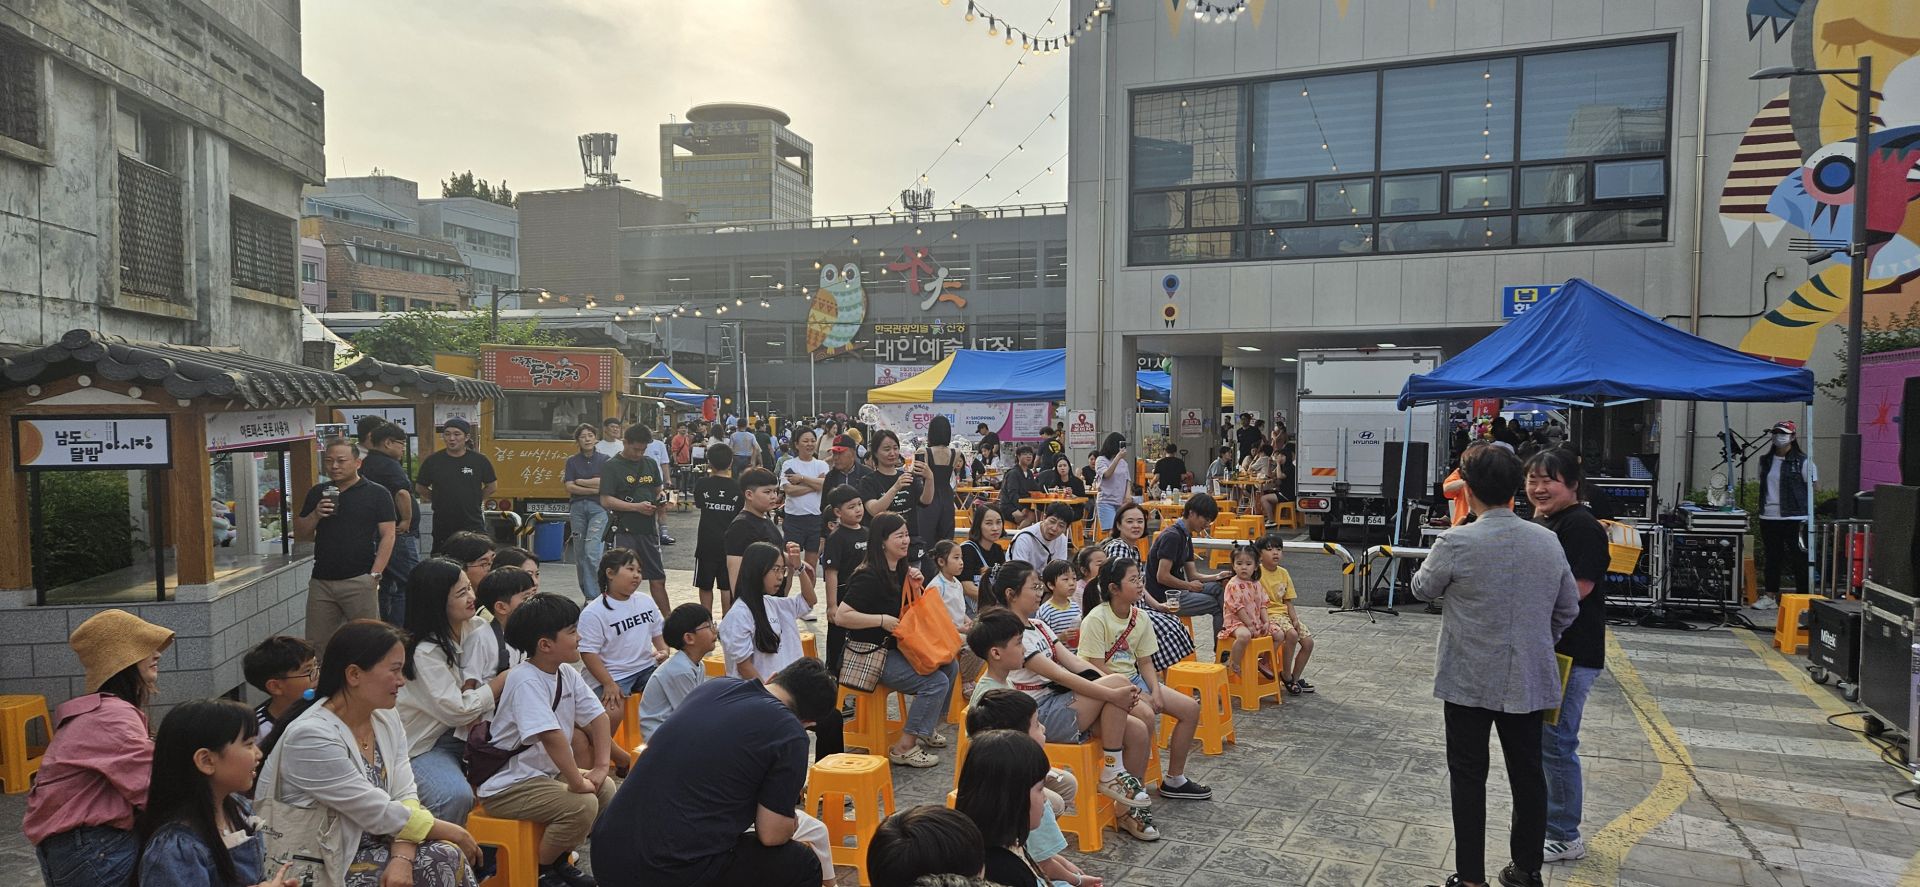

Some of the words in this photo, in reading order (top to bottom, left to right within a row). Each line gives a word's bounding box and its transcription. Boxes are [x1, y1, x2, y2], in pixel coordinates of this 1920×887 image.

[912, 413, 955, 430] 동행제
[705, 502, 735, 512] TIGERS
[610, 610, 655, 636] TIGERS
